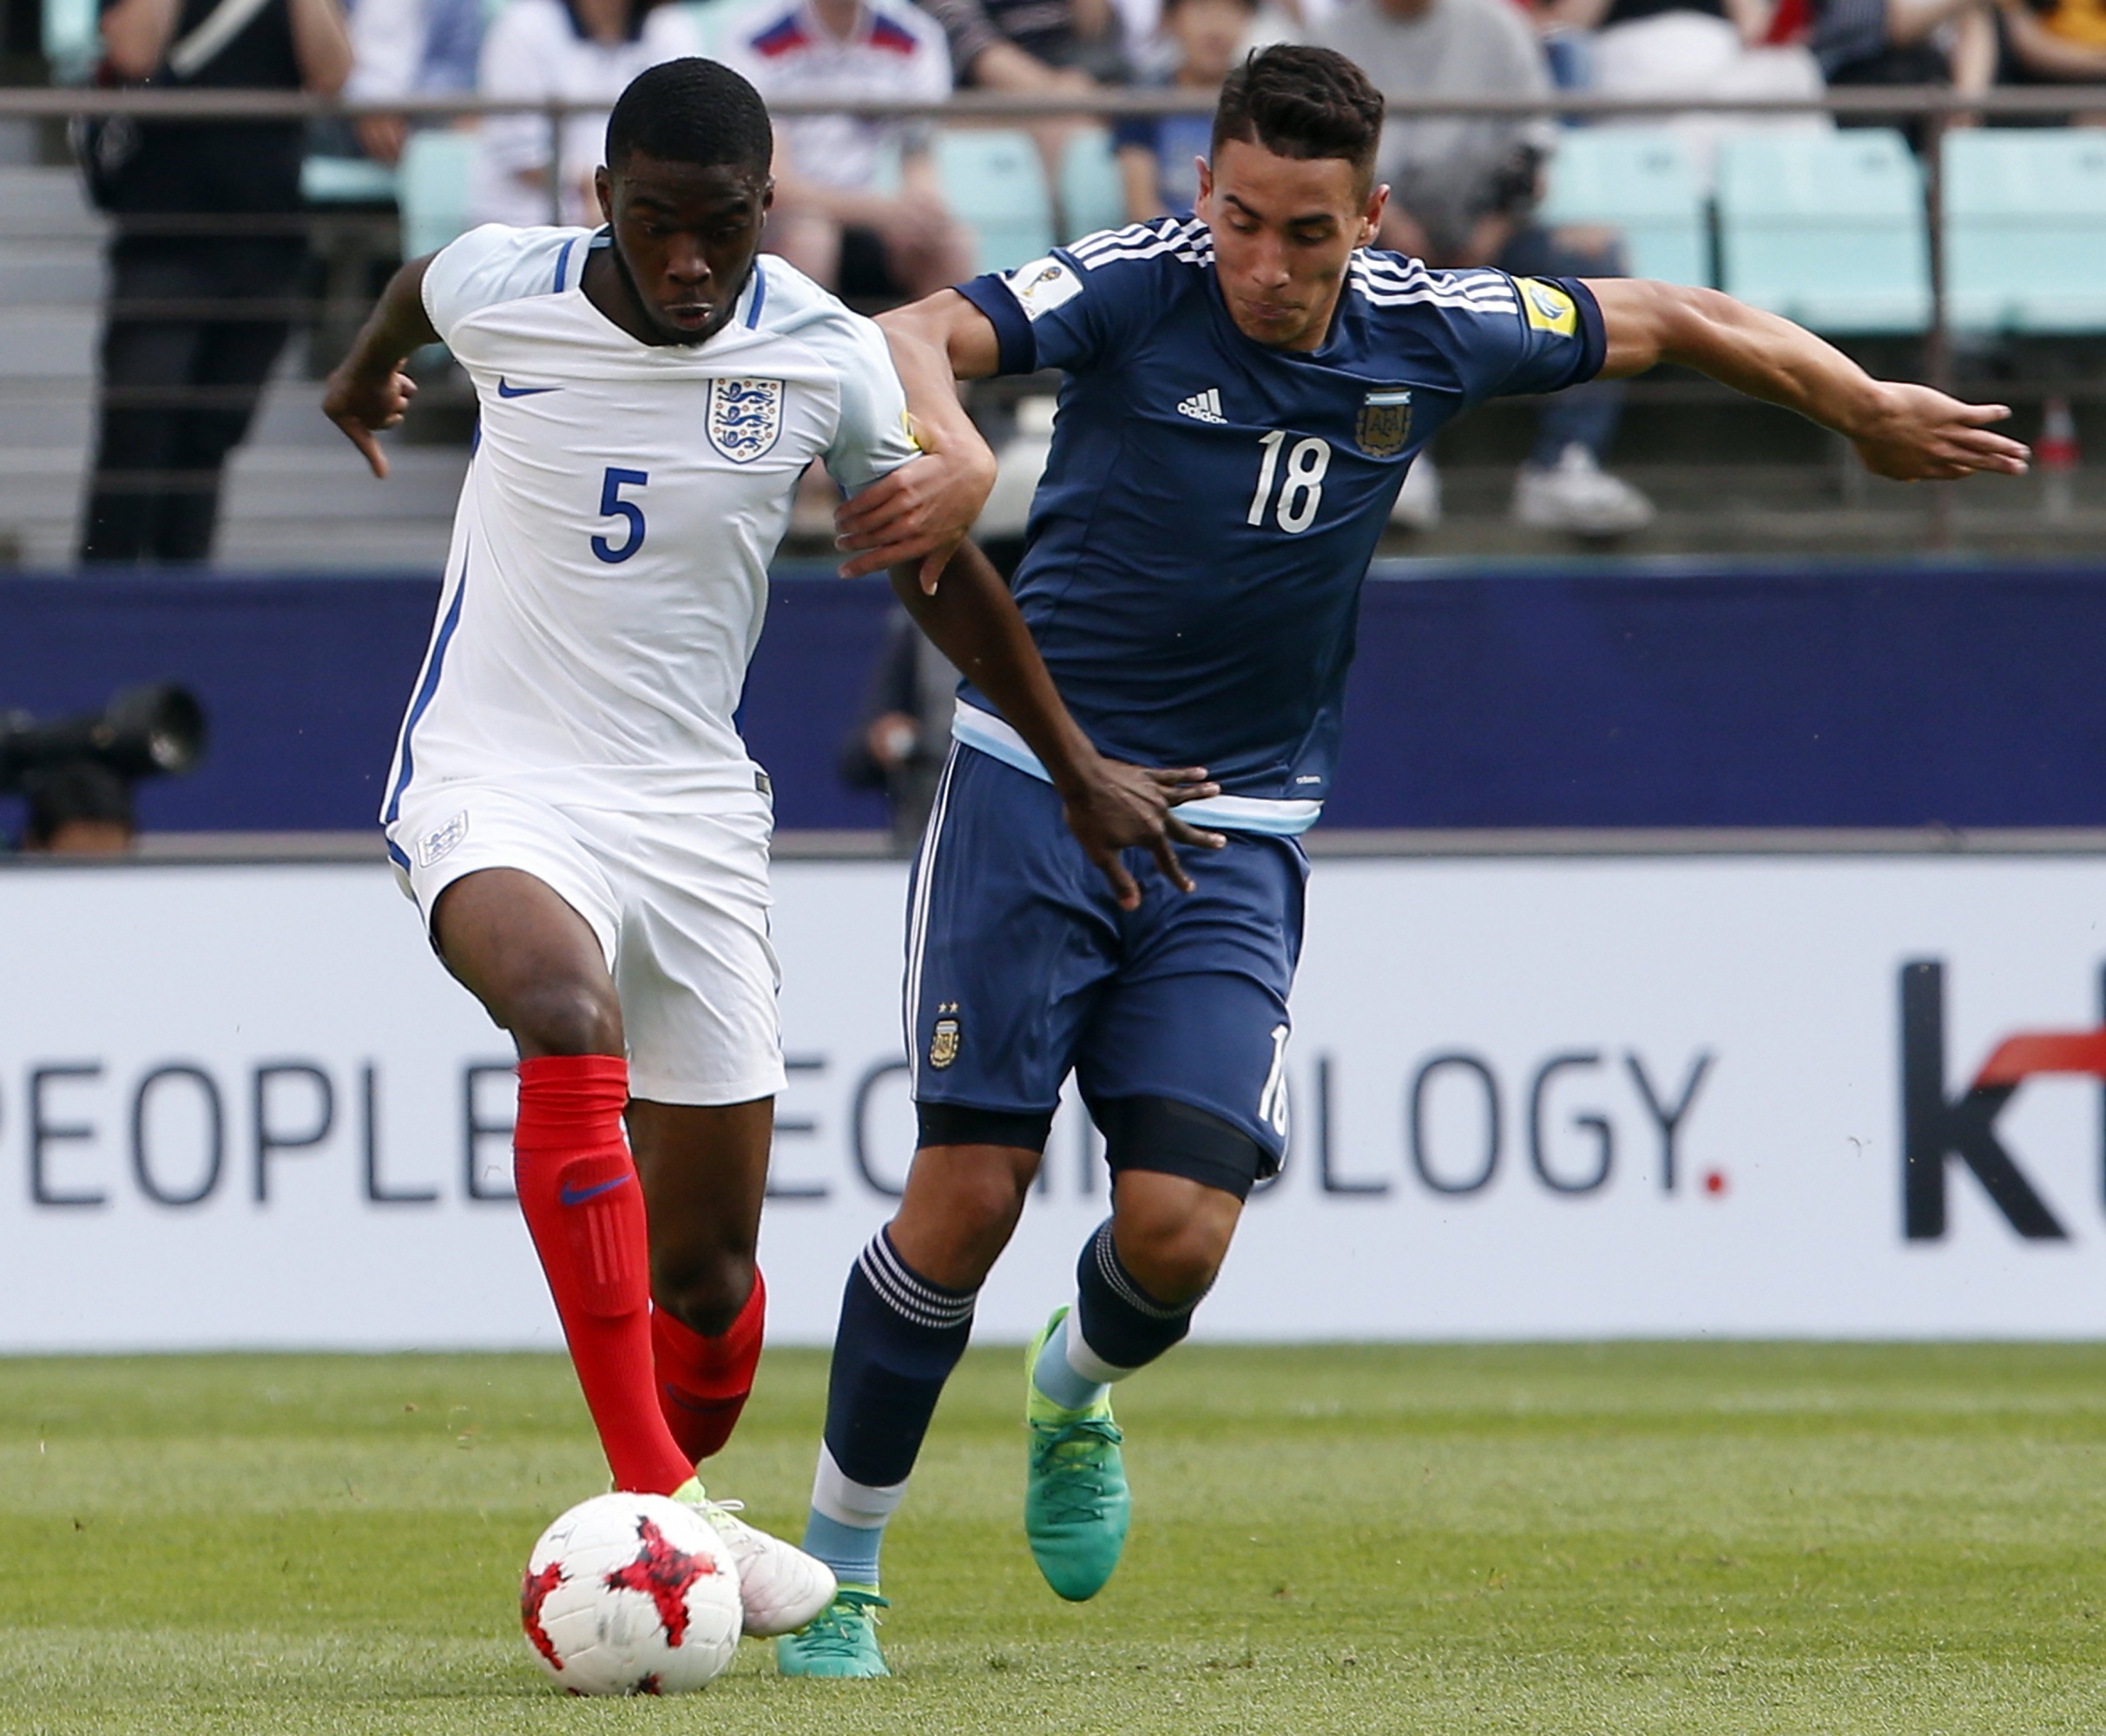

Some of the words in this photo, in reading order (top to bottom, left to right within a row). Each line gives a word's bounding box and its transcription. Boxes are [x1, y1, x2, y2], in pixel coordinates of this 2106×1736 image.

[591, 467, 648, 564] 5
[1247, 430, 1331, 533] 18
[0, 1059, 521, 1206] EOPLE
